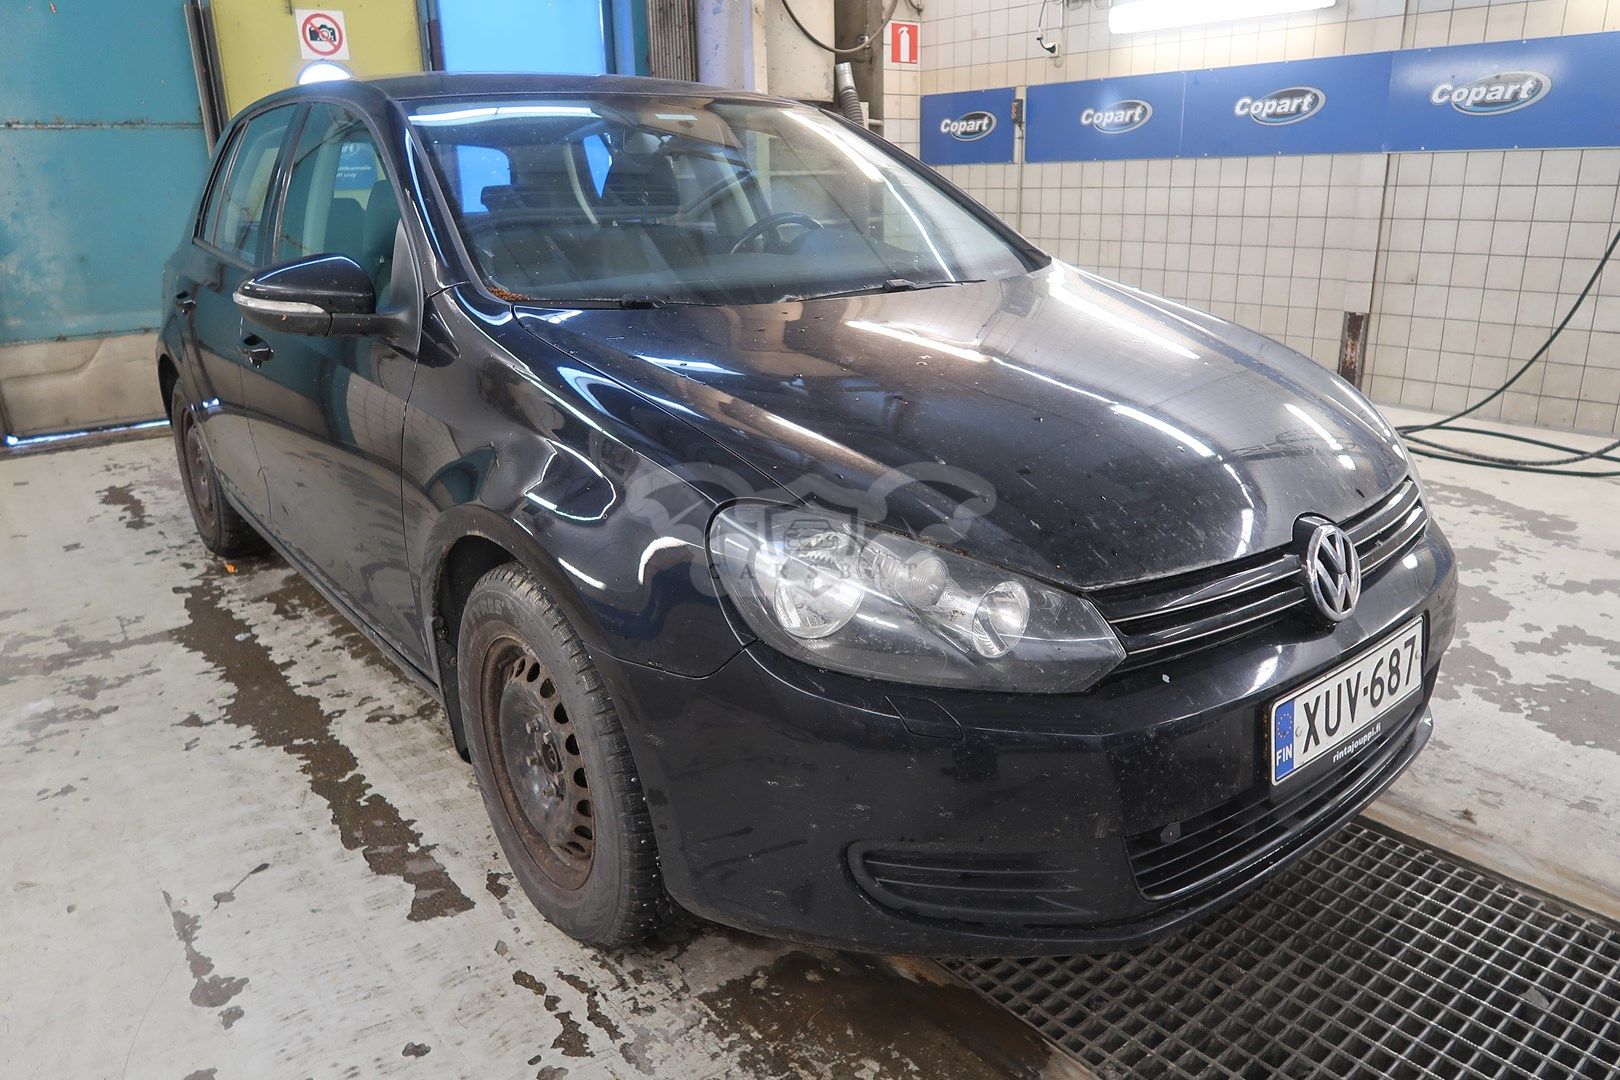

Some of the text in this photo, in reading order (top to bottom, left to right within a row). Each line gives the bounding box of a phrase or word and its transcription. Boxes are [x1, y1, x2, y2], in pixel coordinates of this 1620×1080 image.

[1234, 92, 1316, 118] Copart
[1431, 78, 1536, 108] Copart
[941, 117, 989, 135] Copart
[1081, 105, 1143, 126] Copart
[1302, 634, 1417, 754] XUV-687
[1276, 743, 1293, 766] FIN
[1332, 722, 1381, 763] rintajouppi.fi
